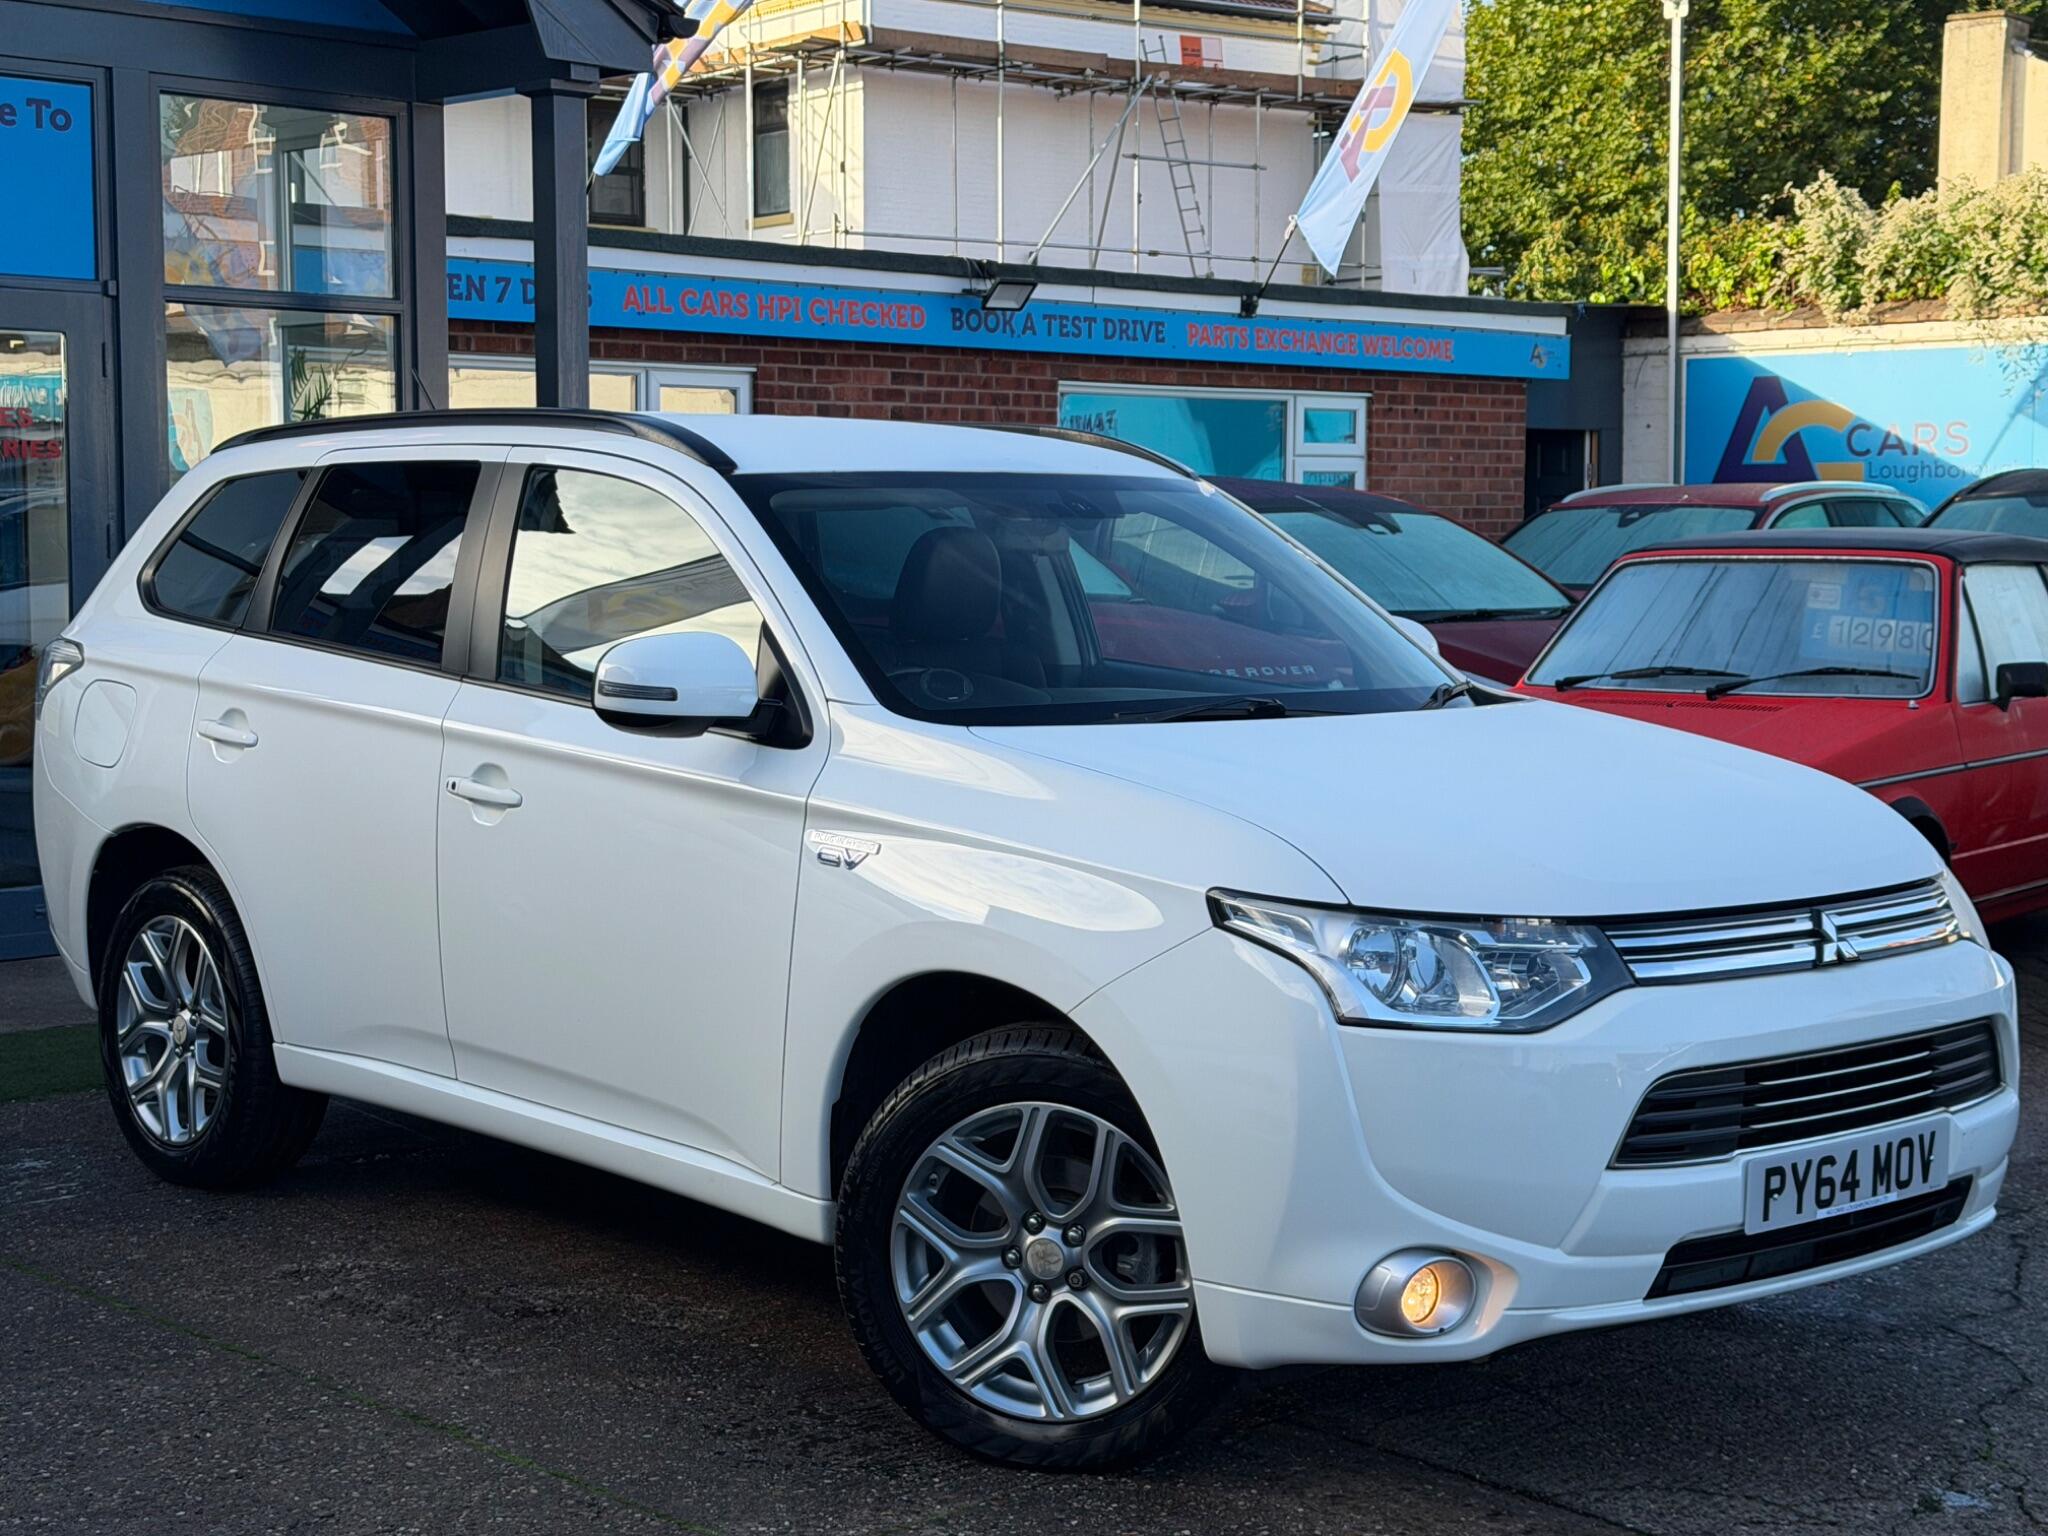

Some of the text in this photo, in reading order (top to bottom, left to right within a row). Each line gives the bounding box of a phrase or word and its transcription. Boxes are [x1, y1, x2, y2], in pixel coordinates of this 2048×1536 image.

[26, 97, 73, 132] To
[495, 277, 512, 304] 7
[623, 285, 927, 330] ALL CARS HPI CHECKED
[951, 307, 1166, 343] BOOK A TEST DRIVE
[1187, 323, 1455, 361] PARTS EXCHANGE WELCOME
[1846, 421, 1969, 457] CARS
[1245, 664, 1316, 677] ROVER
[1763, 1130, 1937, 1222] PY64 MOV
